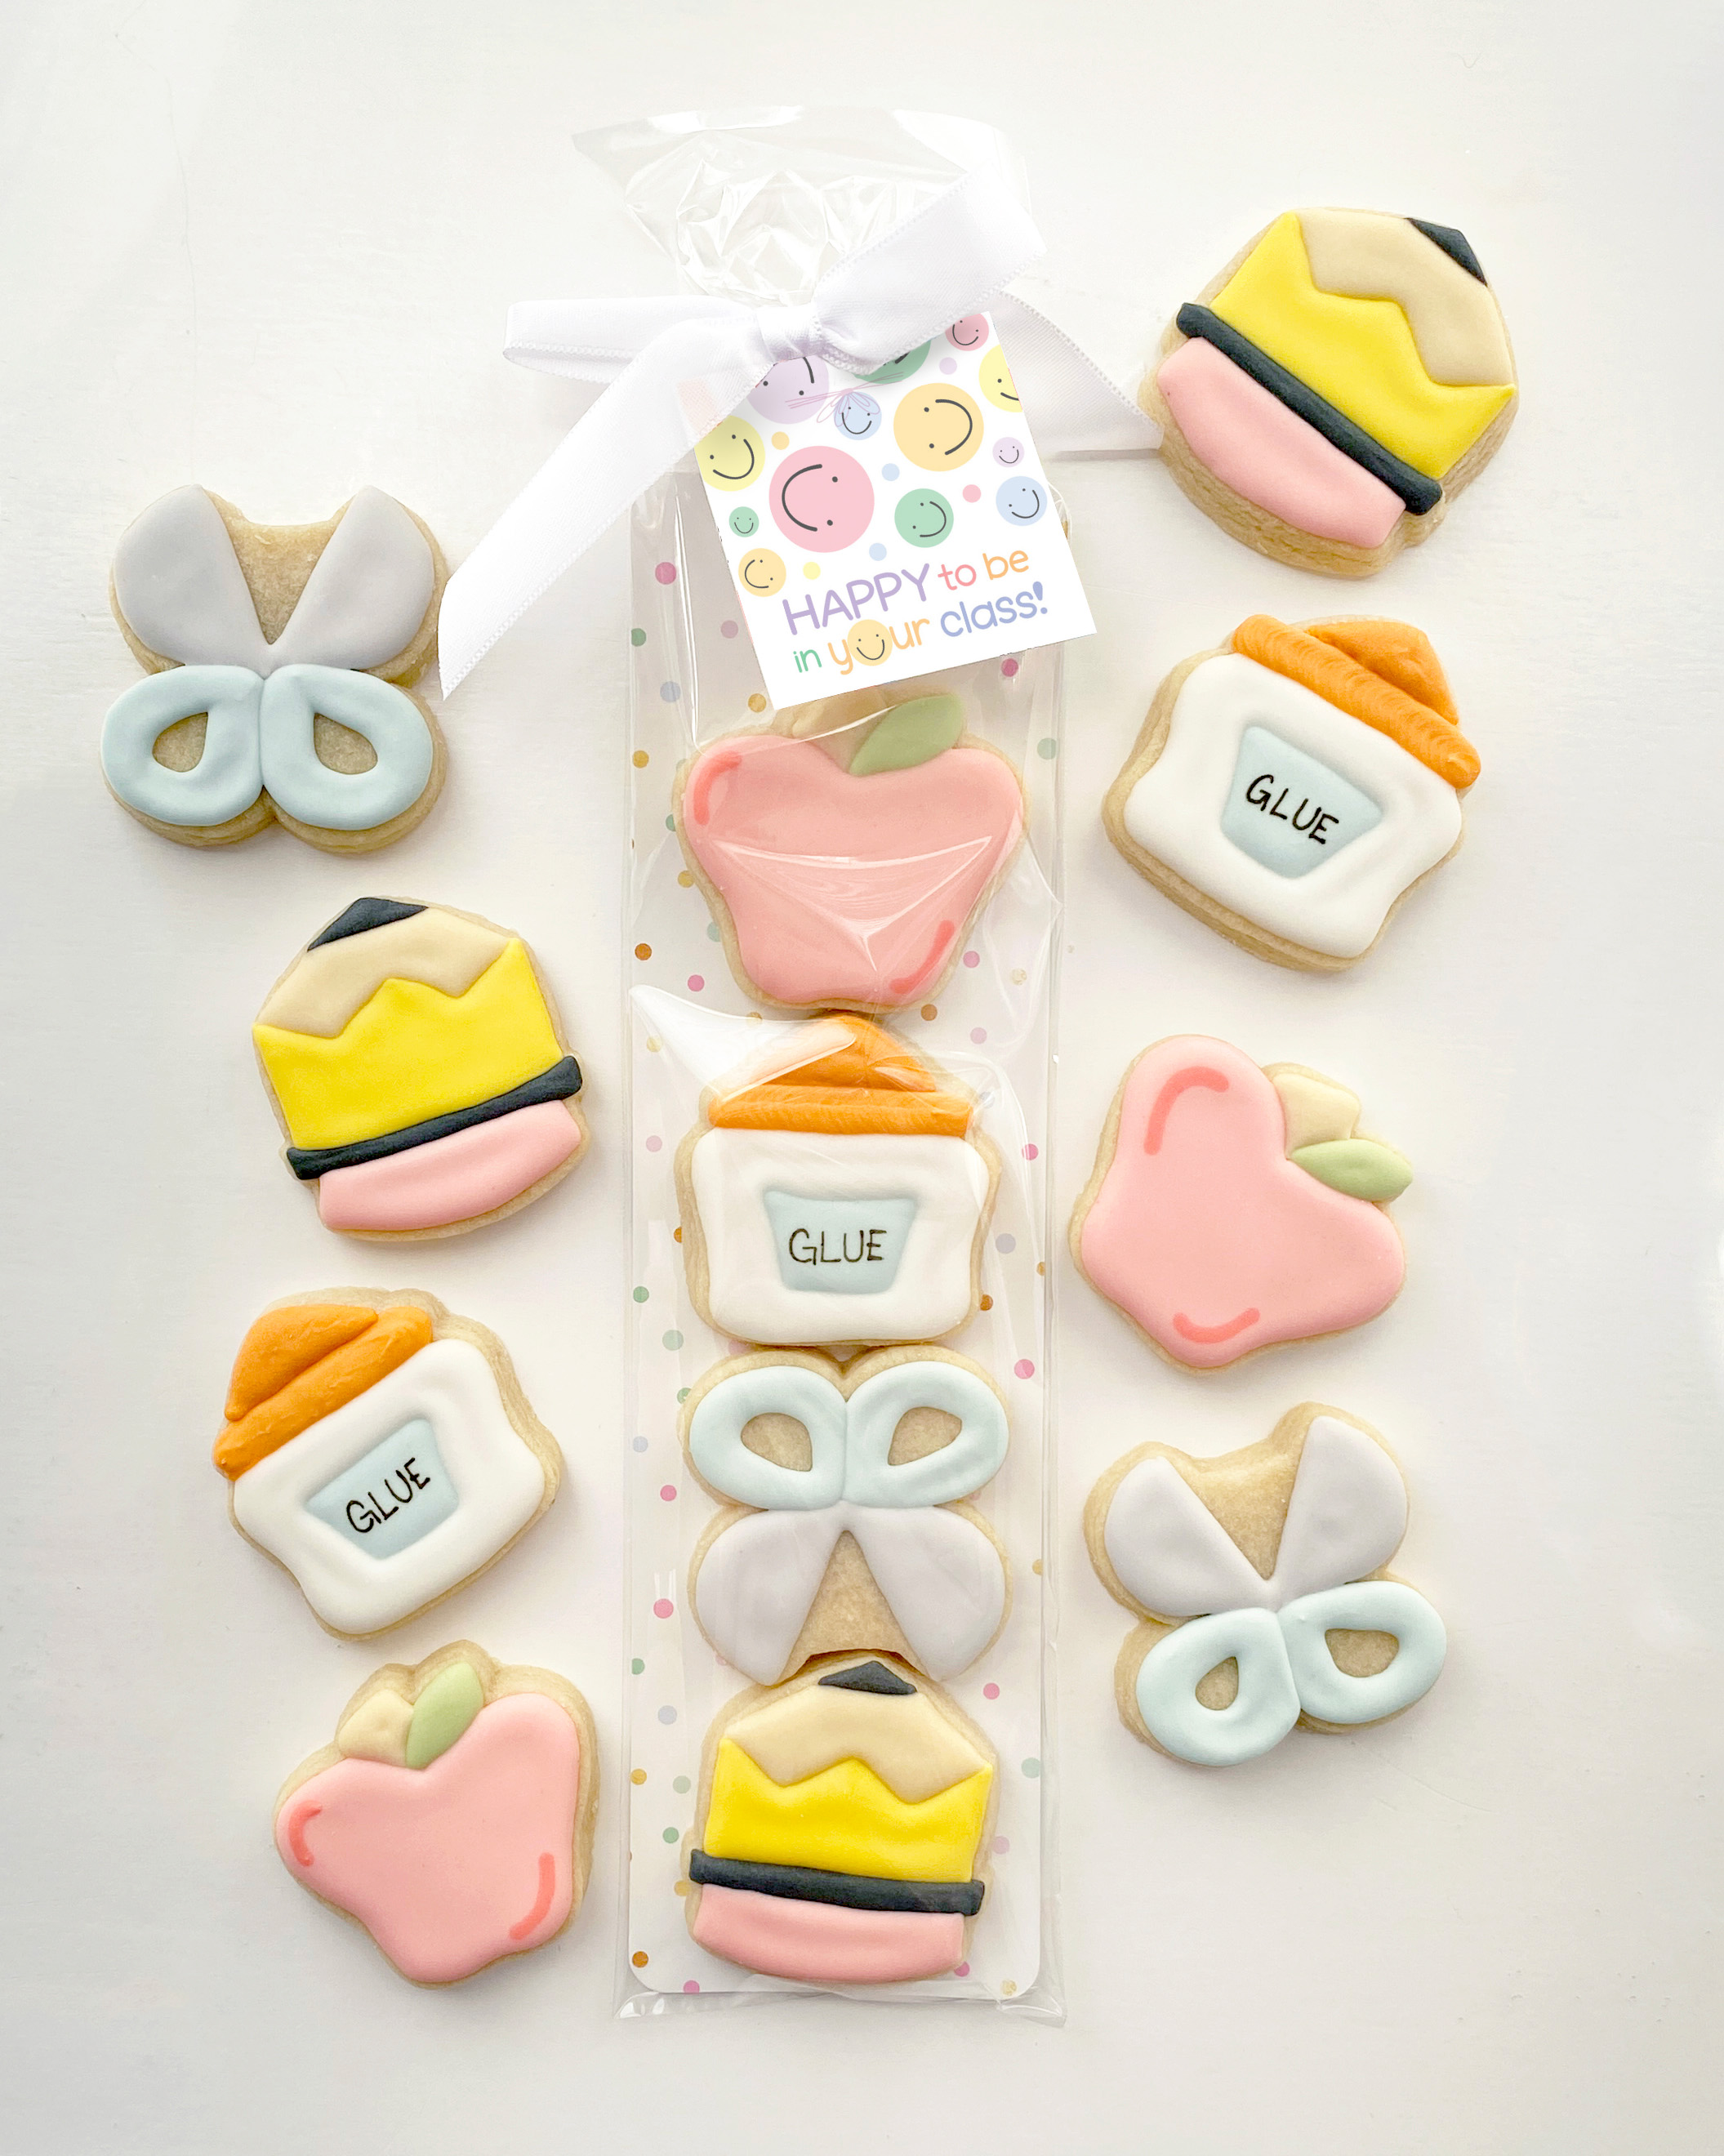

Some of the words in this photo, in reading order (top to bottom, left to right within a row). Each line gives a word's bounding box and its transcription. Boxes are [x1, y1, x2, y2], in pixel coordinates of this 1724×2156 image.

[782, 563, 930, 635] HAPPY
[938, 564, 977, 590] to
[982, 550, 1030, 581] be
[792, 648, 822, 674] in
[827, 617, 930, 675] your
[940, 581, 1049, 638] class!
[1245, 773, 1339, 844] GLUE
[788, 1227, 887, 1266] GLUE
[345, 1457, 430, 1533] GLUE
